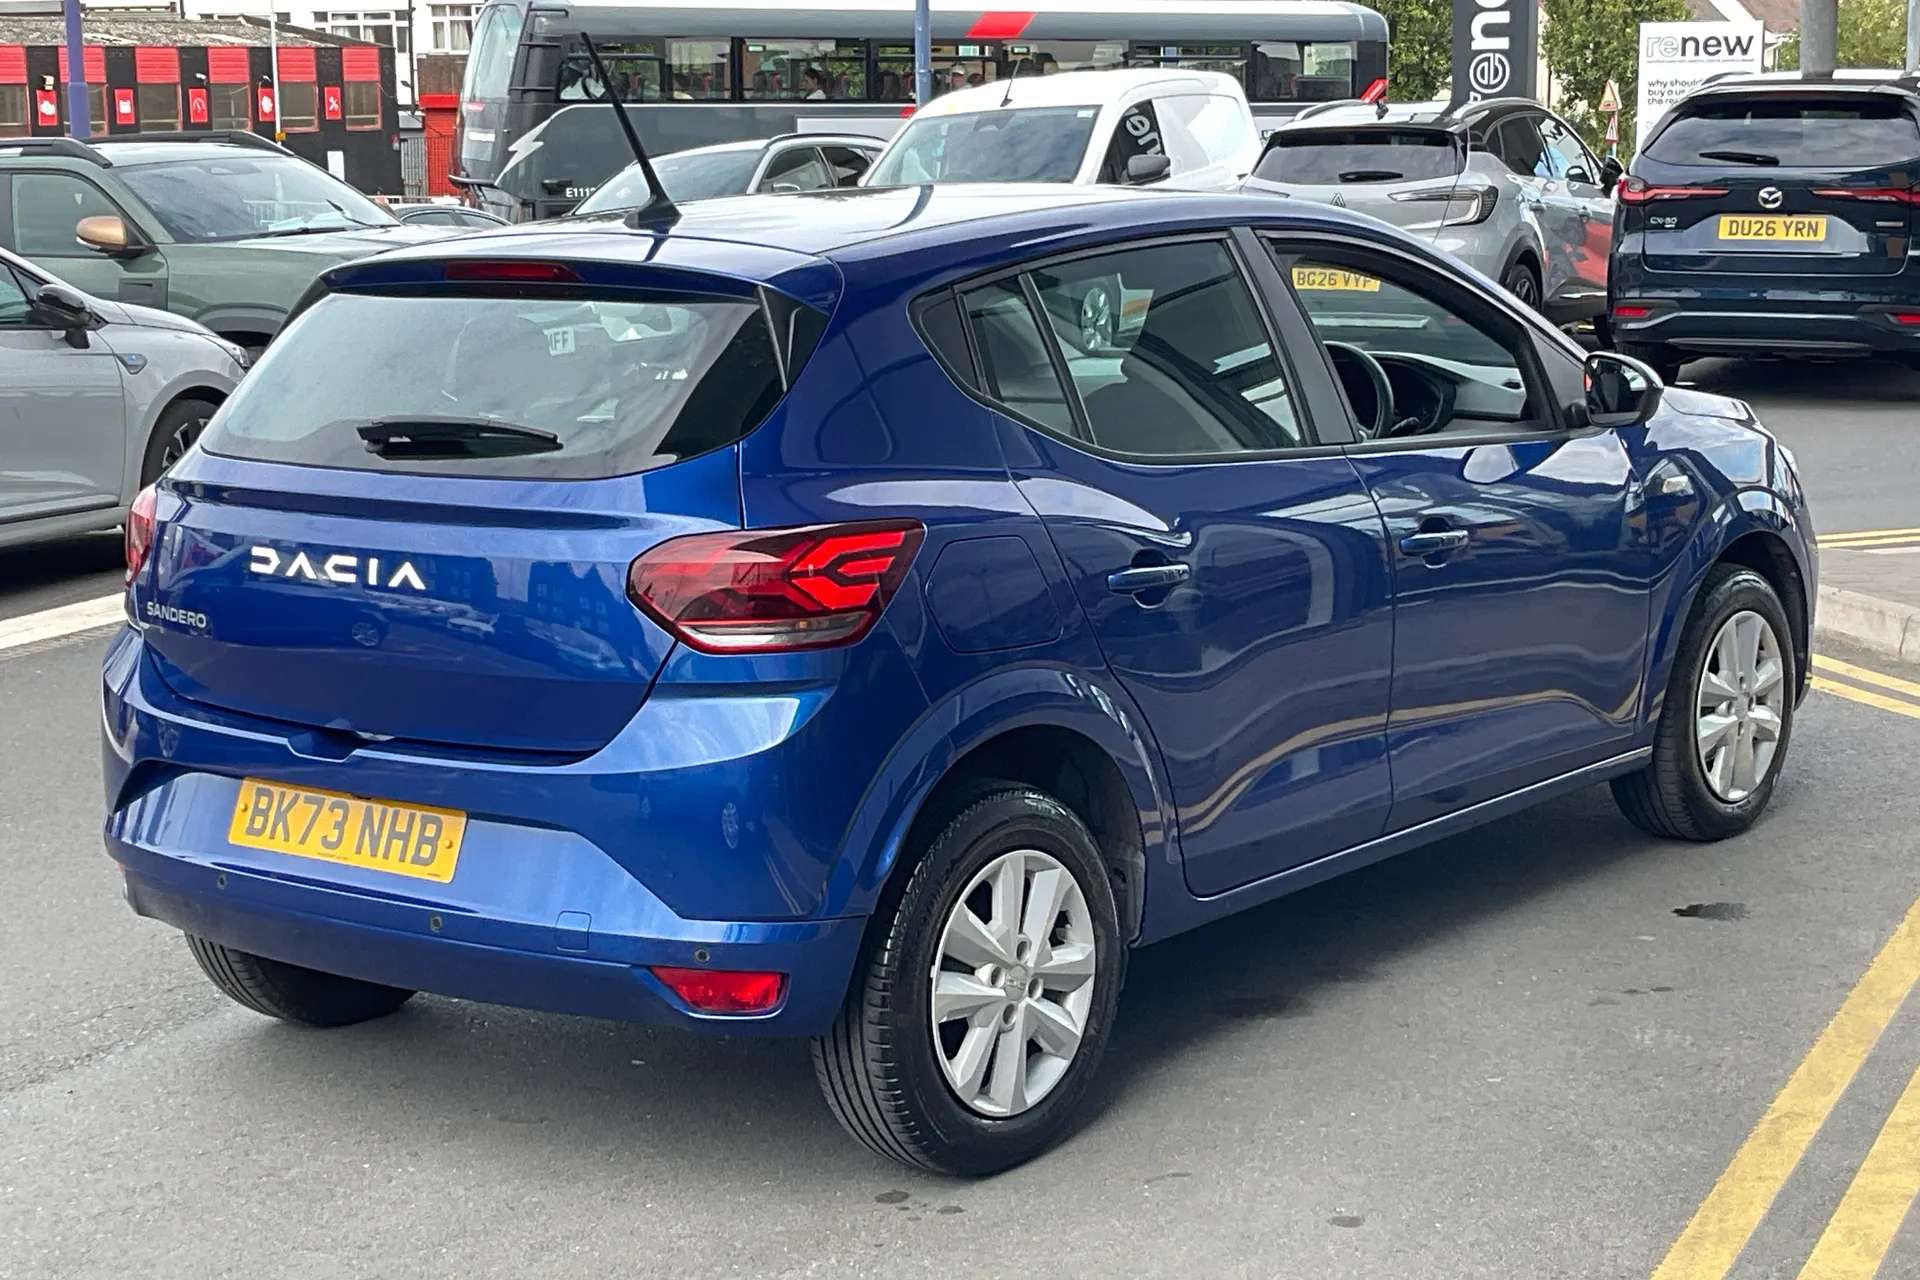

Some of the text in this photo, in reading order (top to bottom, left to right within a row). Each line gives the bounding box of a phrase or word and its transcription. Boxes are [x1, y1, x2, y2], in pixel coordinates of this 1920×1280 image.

[1646, 36, 1755, 58] renew
[1648, 79, 1668, 88] why
[1648, 89, 1665, 97] buy
[1648, 97, 1664, 105] the
[1728, 220, 1818, 238] DU26 YRN
[1297, 271, 1337, 287] BG26
[250, 546, 426, 590] DACIA
[146, 601, 207, 628] SANDERO
[245, 786, 443, 867] BK73 NHB
